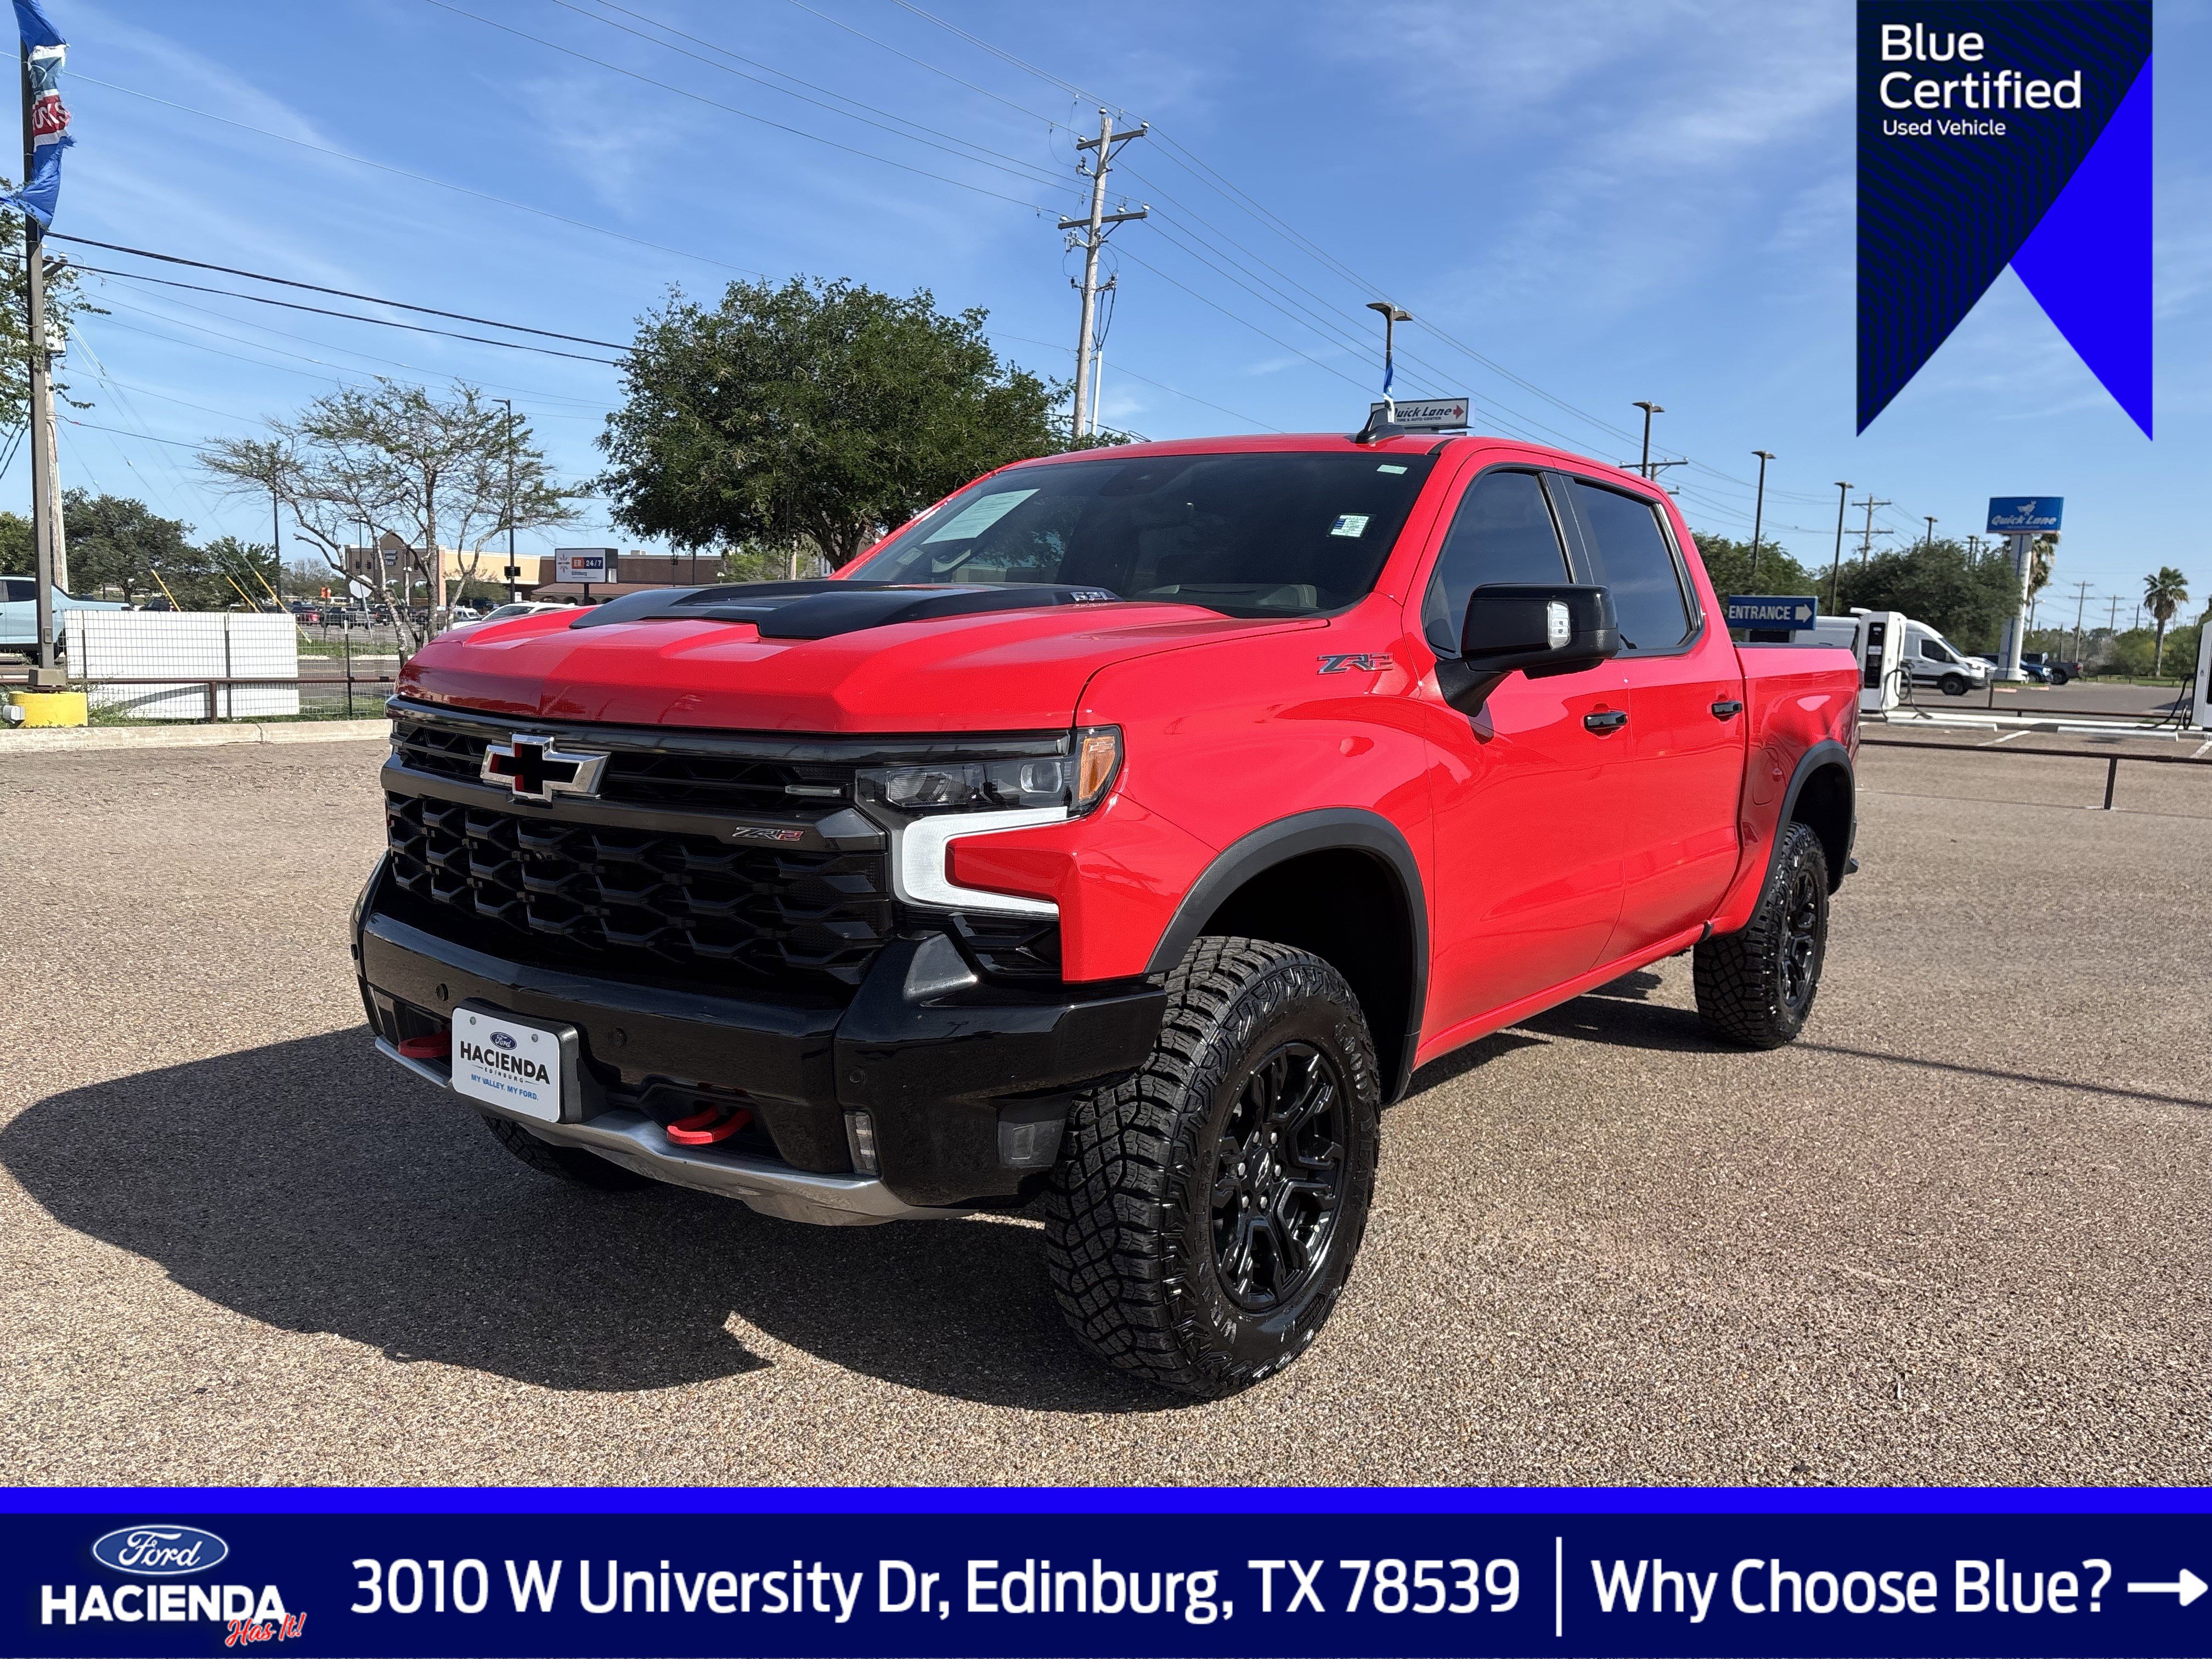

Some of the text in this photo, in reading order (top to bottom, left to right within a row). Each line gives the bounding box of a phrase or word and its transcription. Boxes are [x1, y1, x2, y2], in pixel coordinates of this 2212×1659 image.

[32, 102, 69, 128] UCKS
[1423, 407, 1452, 416] Lane
[1991, 514, 2057, 526] Quick Lane
[573, 559, 602, 567] ER 24/7
[1728, 605, 1791, 620] ENTRANCE
[1317, 652, 1394, 675] ZR2
[732, 825, 806, 842] ZR2
[494, 1034, 512, 1048] Ford
[460, 1040, 550, 1085] HACIENDA
[484, 1066, 523, 1084] EDINBURG
[471, 1074, 539, 1101] MY VALLEY. MY FORD.
